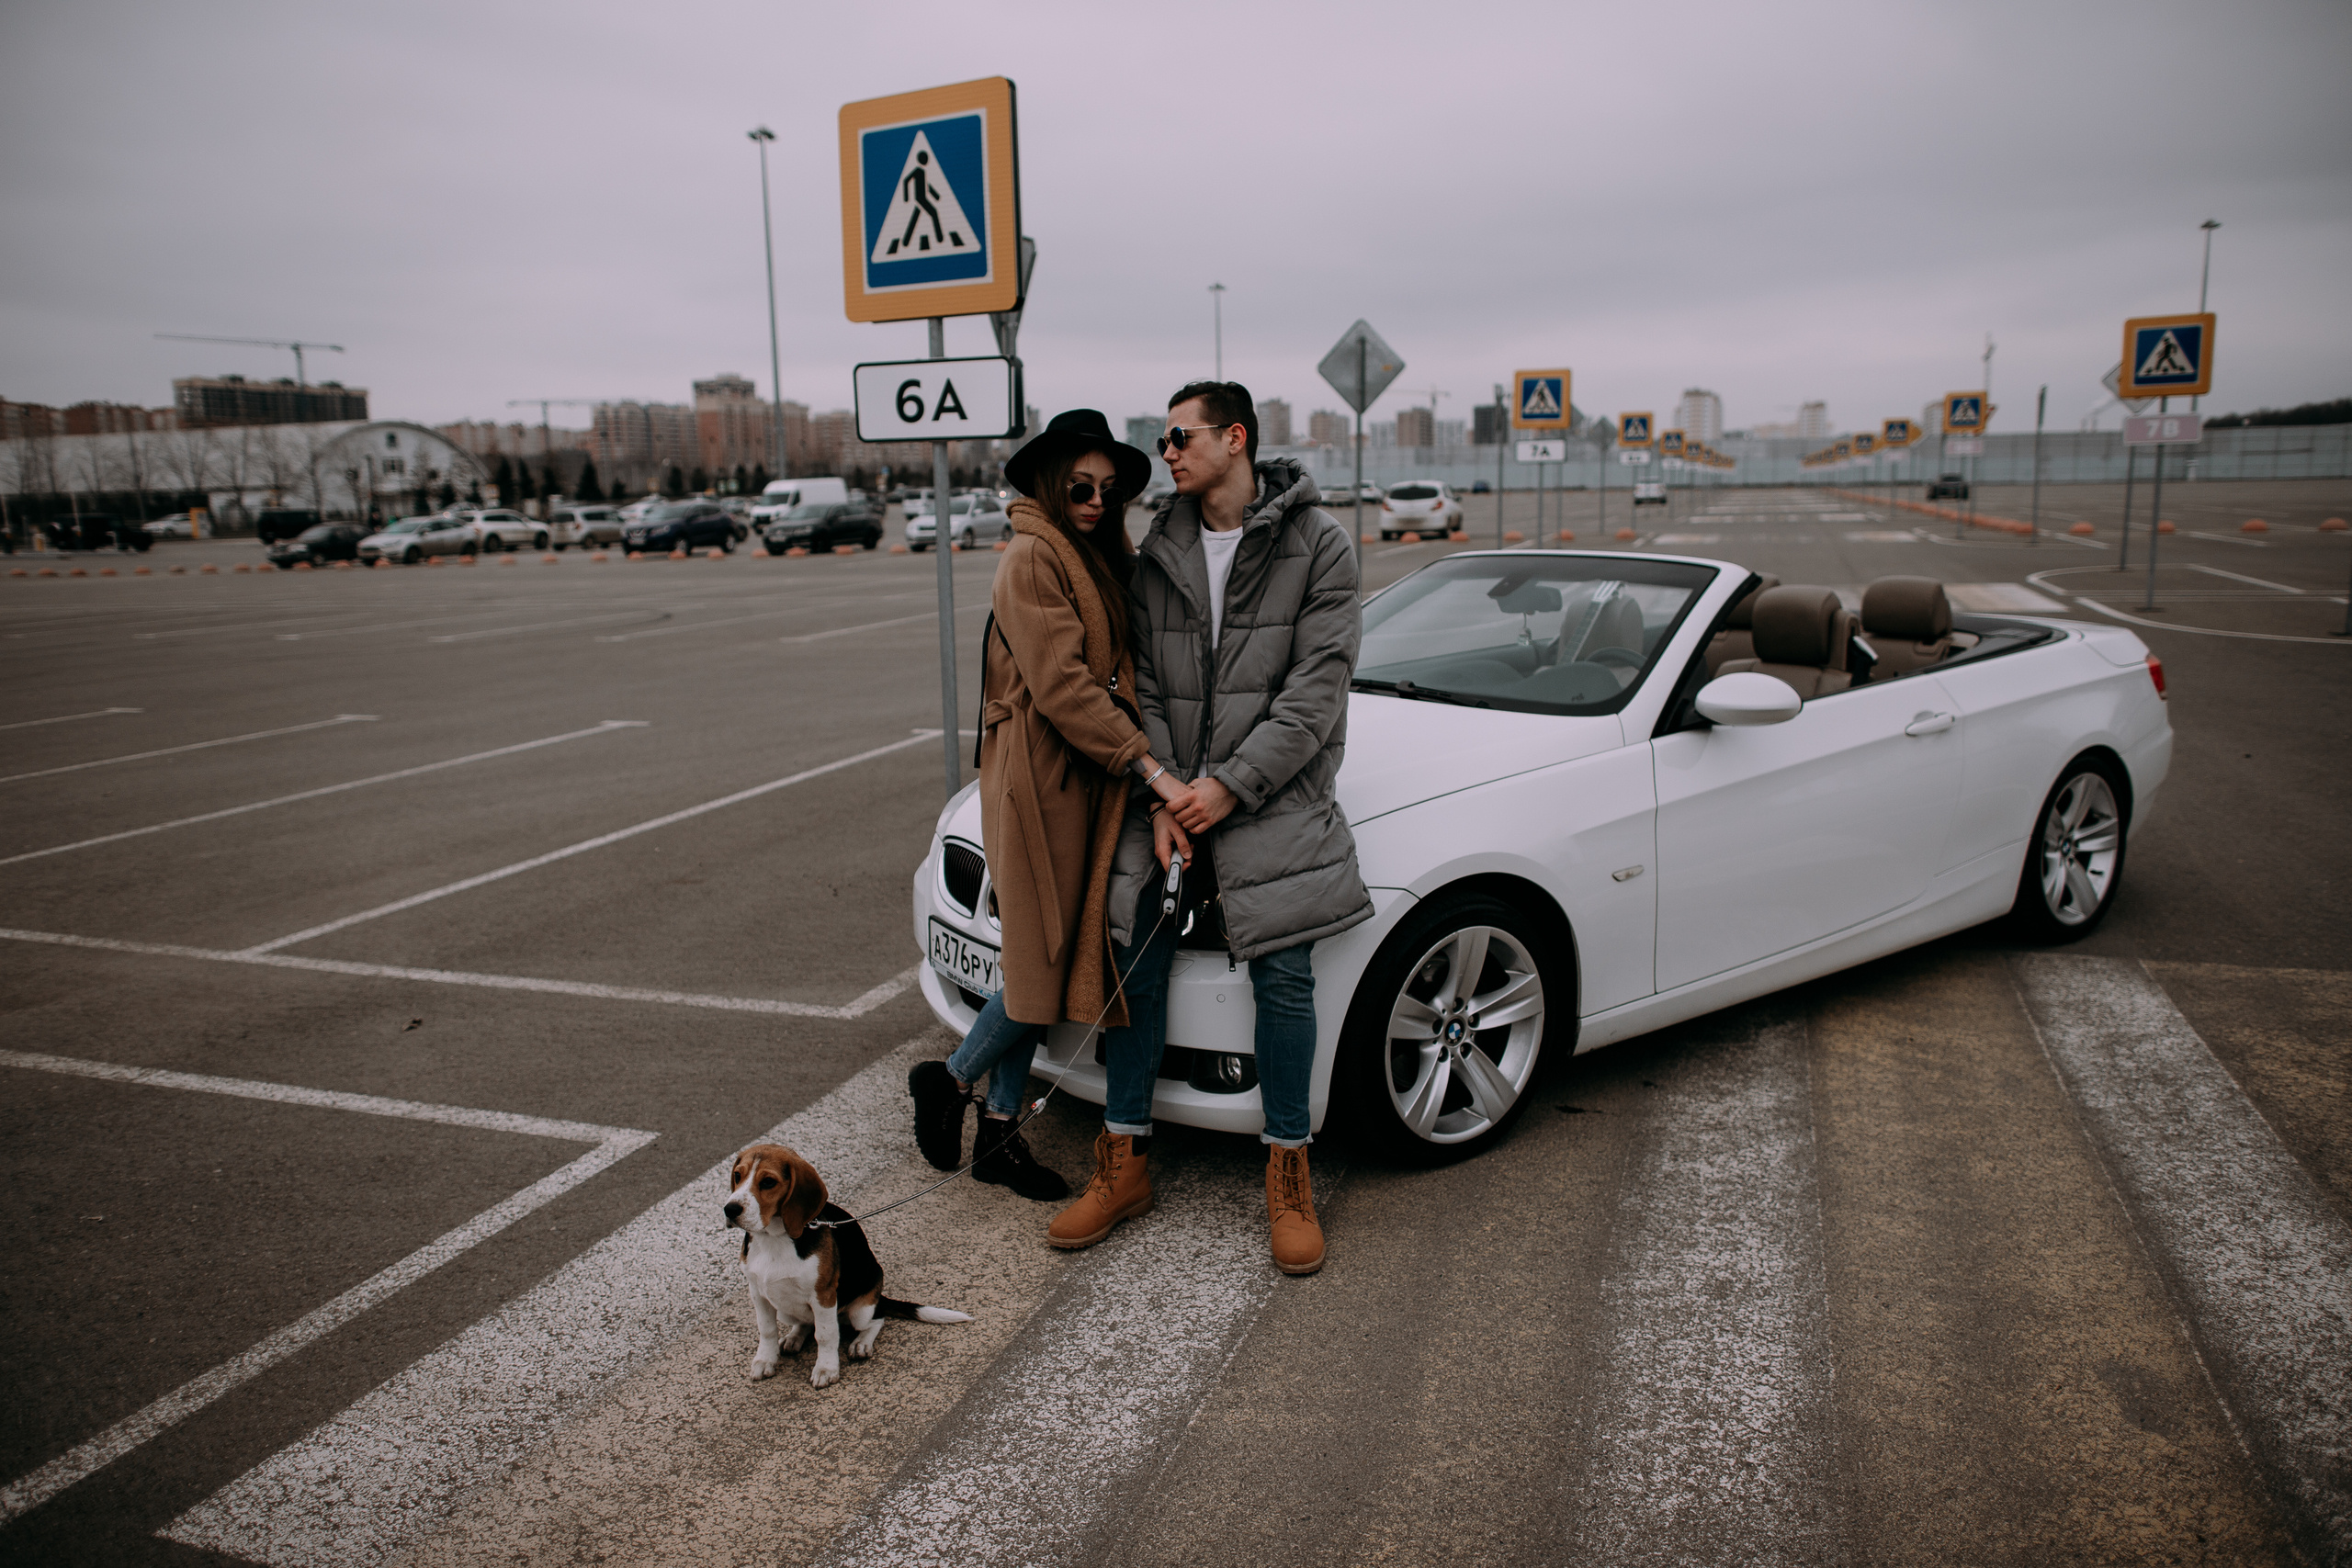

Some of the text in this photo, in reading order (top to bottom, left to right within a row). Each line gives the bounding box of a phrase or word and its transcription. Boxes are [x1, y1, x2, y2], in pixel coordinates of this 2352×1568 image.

[896, 378, 968, 423] 6A
[1532, 445, 1551, 457] 7A
[933, 931, 993, 985] A376PY
[946, 970, 963, 985] BMW
[964, 980, 978, 993] Club
